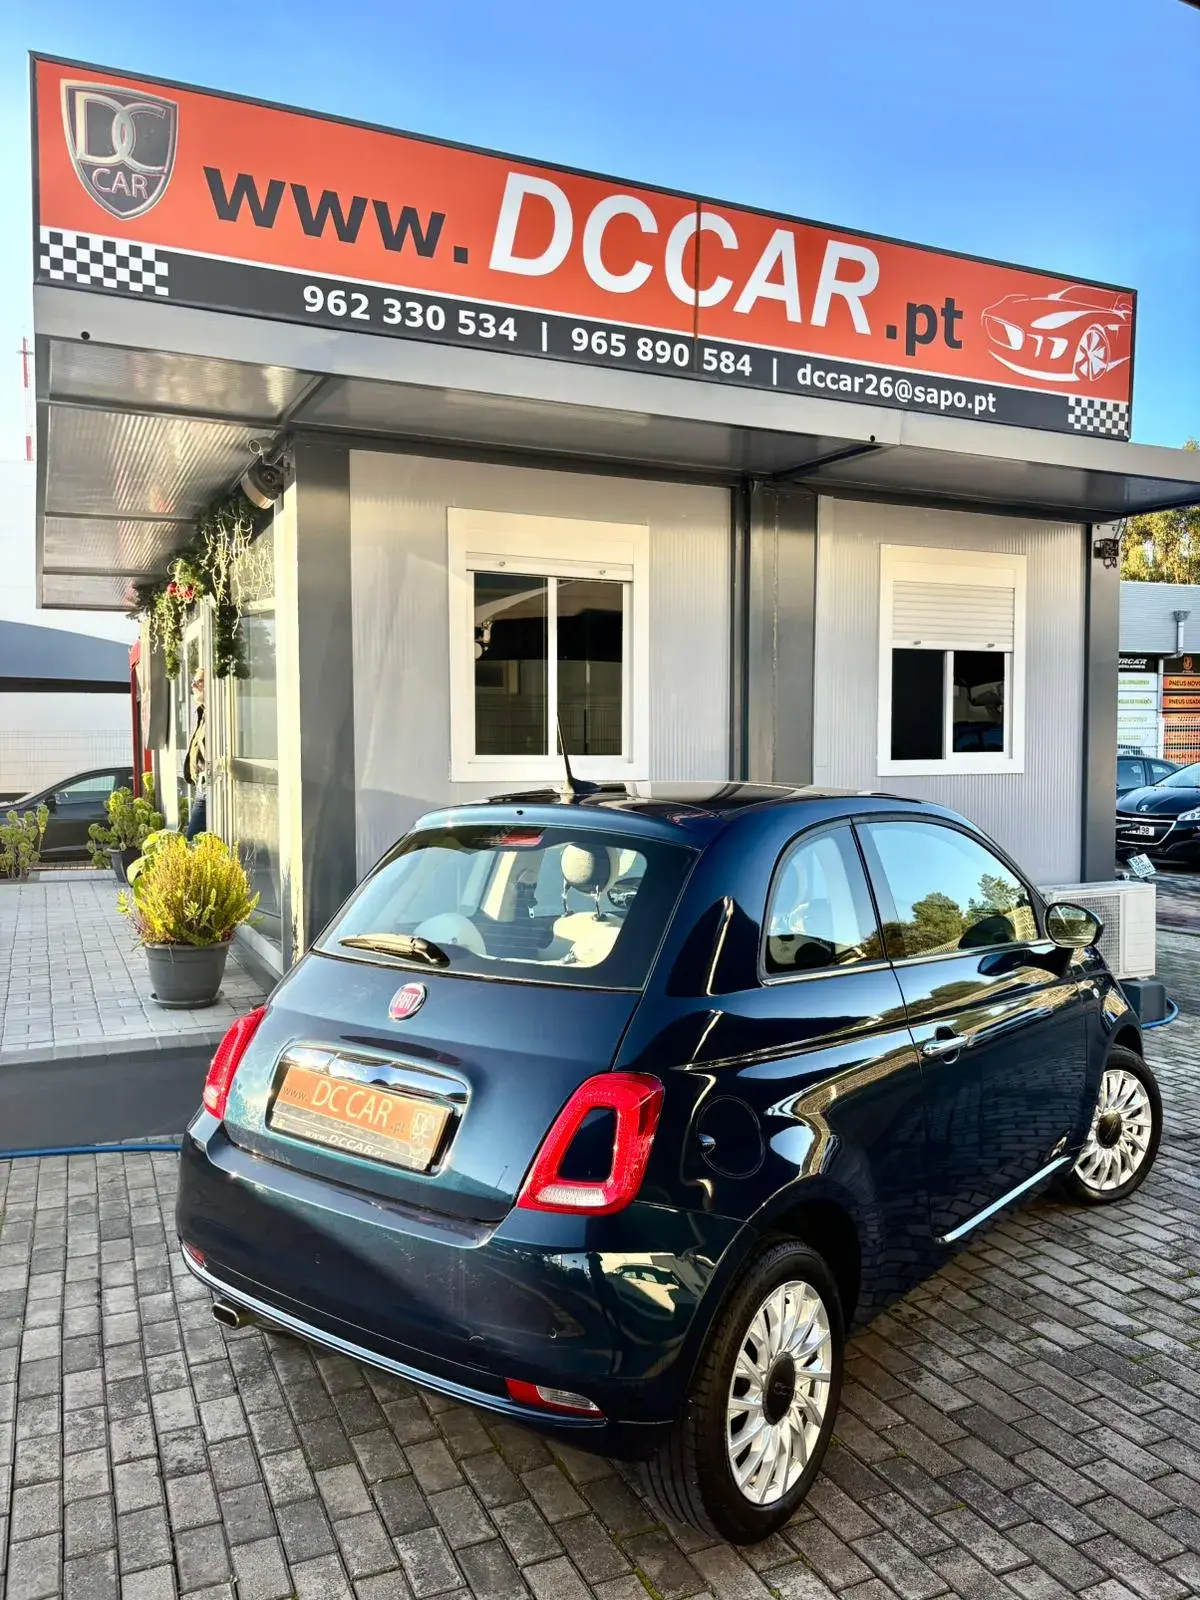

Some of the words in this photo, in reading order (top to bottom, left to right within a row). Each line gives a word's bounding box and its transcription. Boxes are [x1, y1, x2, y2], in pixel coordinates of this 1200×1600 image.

[75, 91, 166, 176] DC
[92, 167, 148, 199] CAR
[303, 285, 370, 321] 962
[382, 297, 446, 331] 330
[458, 309, 518, 342] 534
[571, 327, 627, 357] 965
[636, 337, 690, 367] 890
[702, 347, 753, 377] 584
[796, 363, 997, 415] dccar26@sapo.pt
